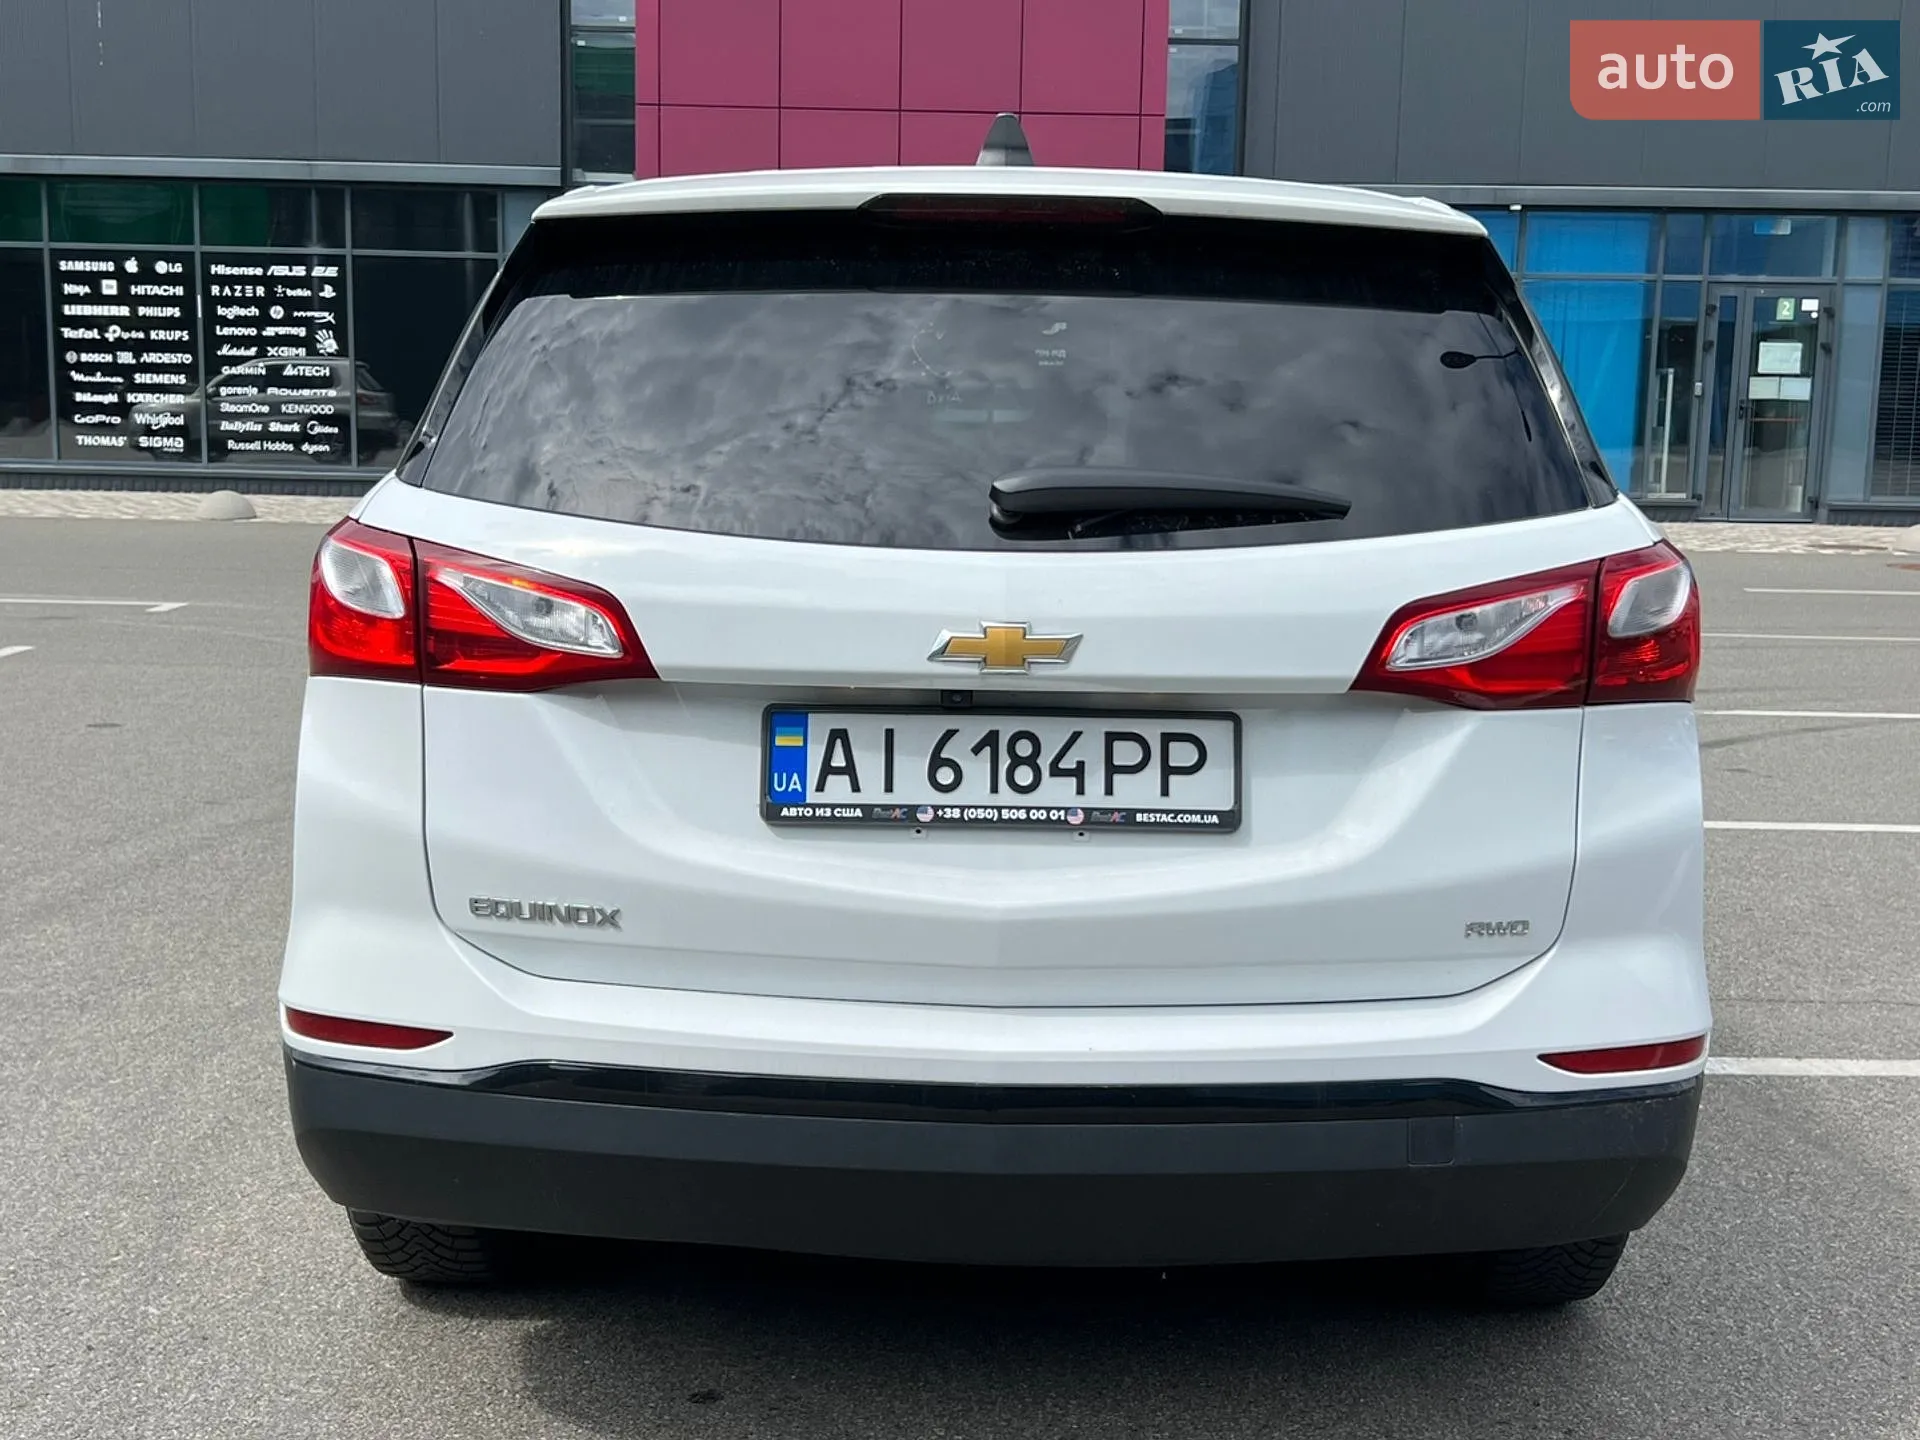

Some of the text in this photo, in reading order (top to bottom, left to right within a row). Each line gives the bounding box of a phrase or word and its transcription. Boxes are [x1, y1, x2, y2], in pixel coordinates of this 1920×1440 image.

[59, 260, 183, 273] SAMSUNG LG
[210, 264, 264, 276] Hisense
[266, 265, 307, 276] ASUS
[130, 285, 184, 296] HITACHI
[211, 285, 265, 297] RAZER
[63, 304, 181, 317] LIEBHERR PHILIPS
[217, 305, 259, 320] logitech
[1781, 301, 1791, 316] 2
[150, 330, 189, 341] KRUPS
[216, 325, 257, 336] Lenovo
[267, 346, 306, 357] XGIMI
[80, 353, 113, 363] BOSCH
[140, 352, 192, 364] ARDESTO
[221, 365, 266, 375] GARMIN
[133, 373, 187, 384] SIEMENS
[219, 385, 258, 397] gorenje
[220, 402, 335, 415] SteamOne KENWOOD
[74, 412, 184, 430] GoPro Whirlpool
[268, 422, 301, 432] Shark
[76, 435, 126, 447] THOMAS
[227, 439, 330, 454] Russell Hobbs dyson
[773, 772, 803, 793] UA
[780, 807, 863, 818] АВТО ИЗ США
[936, 807, 1066, 821] +38 (050) 506 00 01
[1135, 812, 1220, 825] BESTAC.COM.UA
[469, 897, 623, 930] EQUINOX
